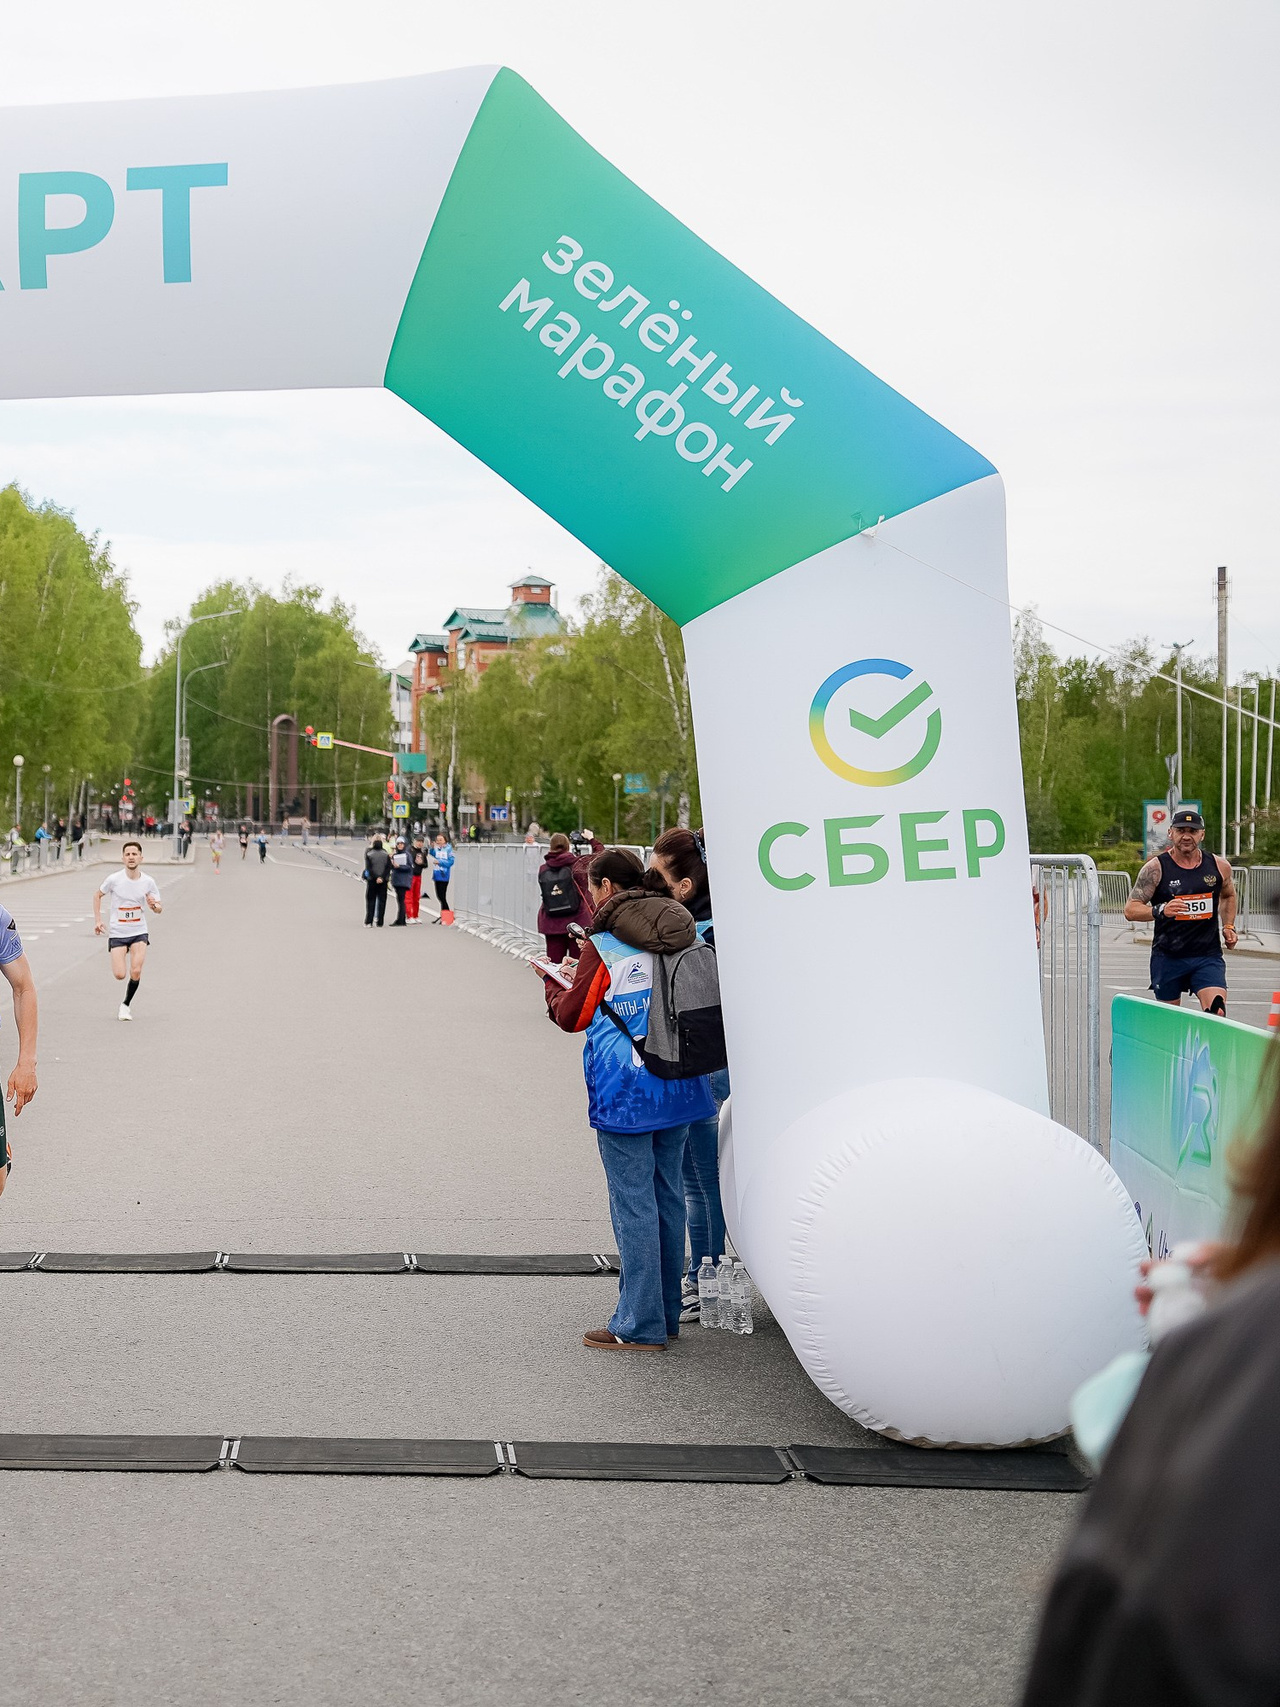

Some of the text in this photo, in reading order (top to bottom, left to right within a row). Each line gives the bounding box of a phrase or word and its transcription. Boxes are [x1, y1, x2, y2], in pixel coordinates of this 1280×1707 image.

[498, 277, 754, 493] марафон
[541, 234, 805, 446] зелёный
[758, 808, 1006, 892] СБЕР
